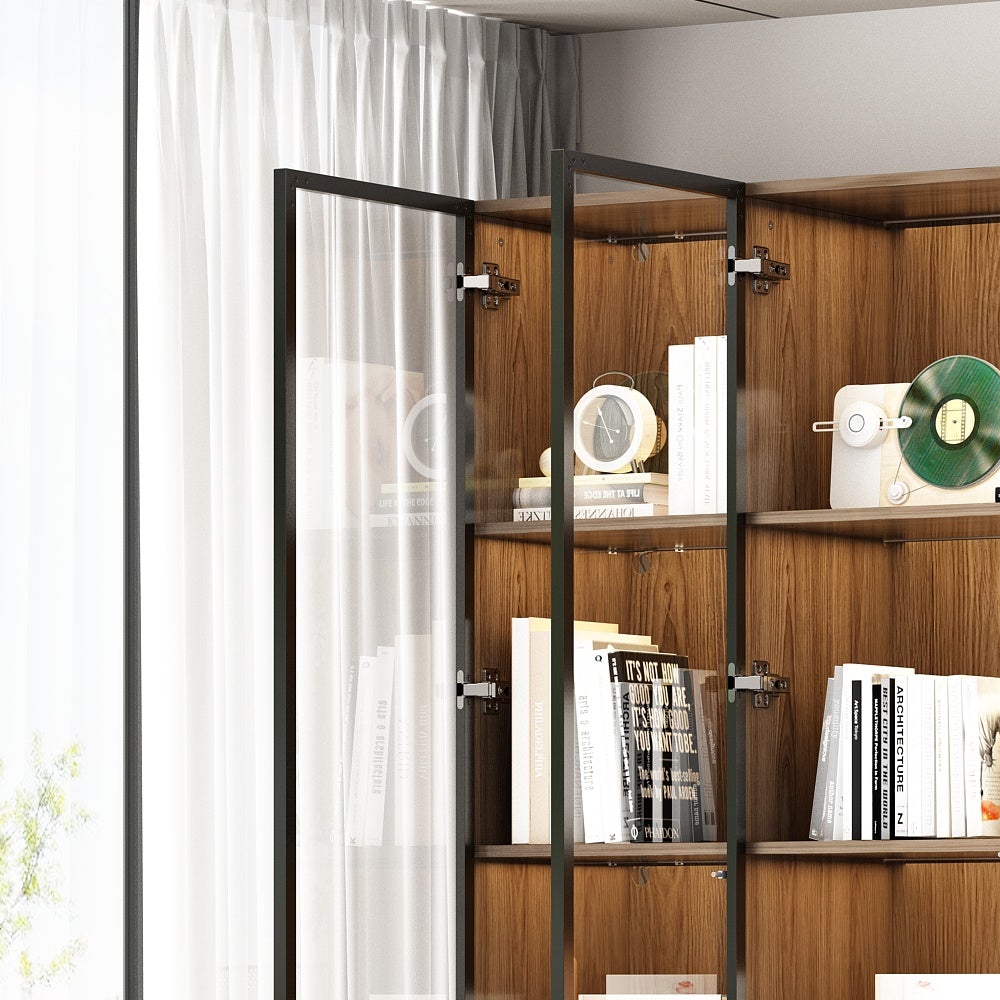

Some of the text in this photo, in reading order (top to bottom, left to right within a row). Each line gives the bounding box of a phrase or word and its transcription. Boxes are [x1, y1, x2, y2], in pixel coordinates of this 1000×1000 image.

[625, 659, 679, 685] IT'S NOT HOW
[629, 683, 691, 710] GOOD YOU ARE,
[631, 707, 690, 730] IT'S HOW GOOD
[634, 730, 651, 751] YOU
[651, 731, 673, 752] WANT
[896, 686, 904, 792] ARCHITECTURE
